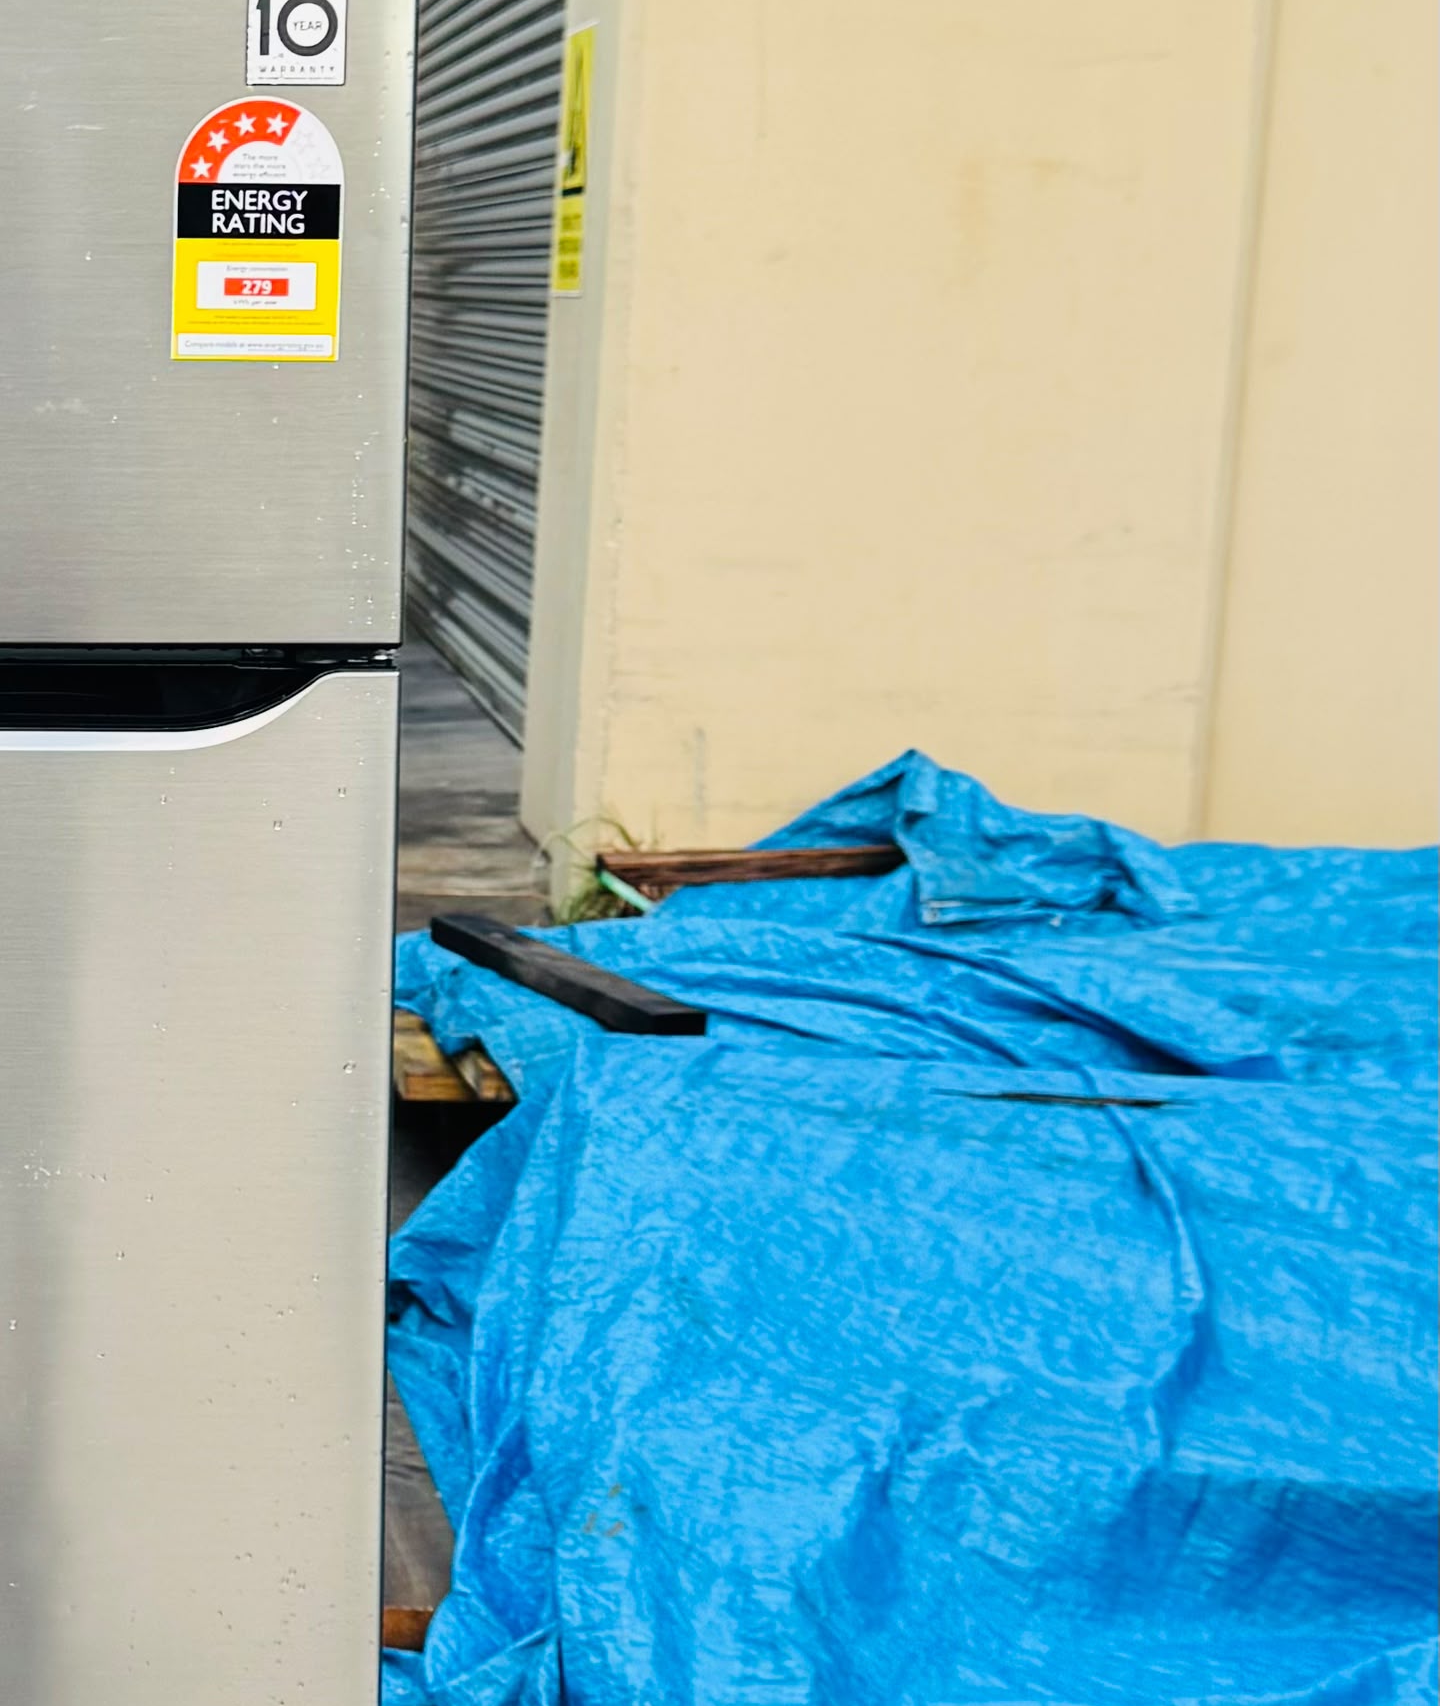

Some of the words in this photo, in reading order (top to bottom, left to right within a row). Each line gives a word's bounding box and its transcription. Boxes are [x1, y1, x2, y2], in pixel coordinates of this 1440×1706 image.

[293, 21, 322, 31] YEAR
[258, 65, 334, 73] WARRANTY
[211, 189, 308, 211] ENERGY
[212, 213, 305, 234] RATING
[241, 279, 273, 295] 279
